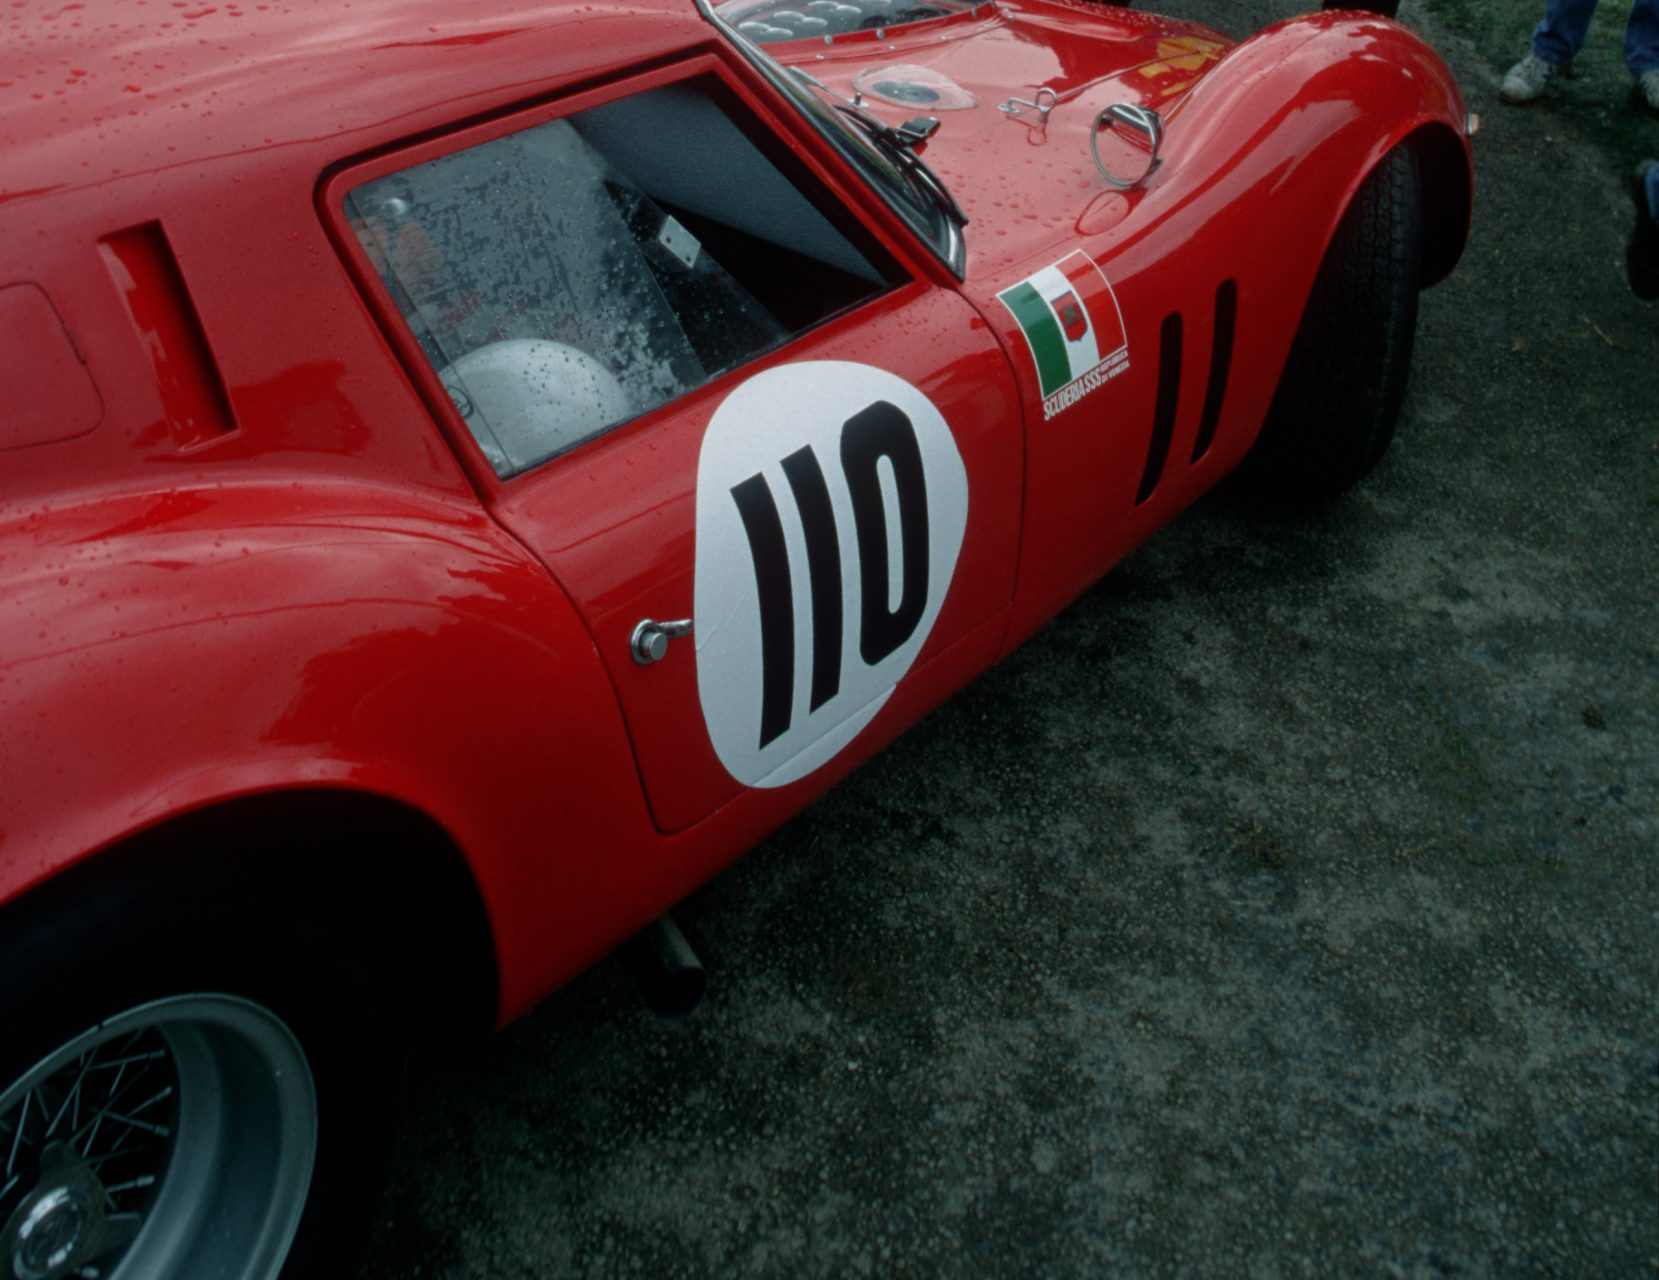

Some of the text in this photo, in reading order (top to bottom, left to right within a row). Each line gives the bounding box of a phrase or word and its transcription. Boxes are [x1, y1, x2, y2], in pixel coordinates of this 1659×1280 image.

[1043, 367, 1102, 421] SCUDERIA SSS
[729, 400, 929, 750] 110
